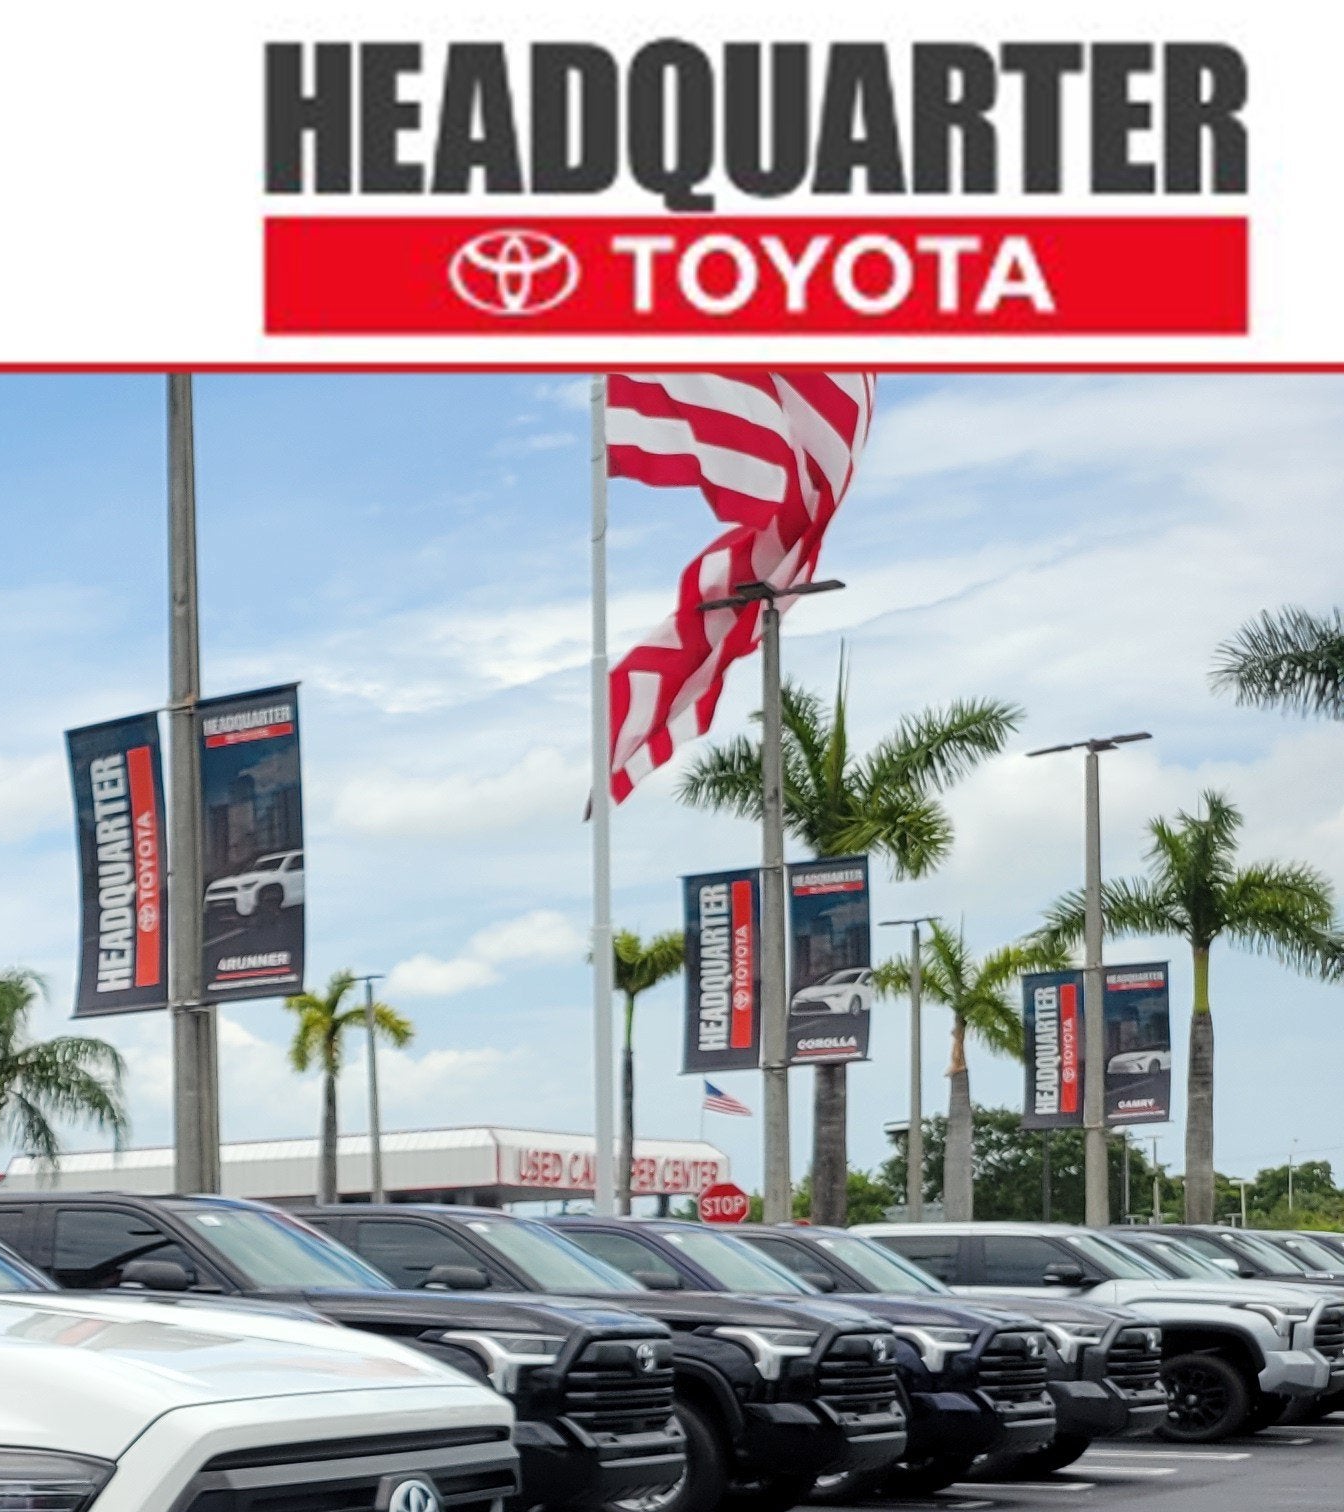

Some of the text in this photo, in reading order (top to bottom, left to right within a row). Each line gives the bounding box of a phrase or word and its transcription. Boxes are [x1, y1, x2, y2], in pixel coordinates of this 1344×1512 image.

[90, 753, 134, 993] HEADQUARTER
[136, 811, 155, 901] TOYOTA
[698, 883, 732, 1051] HEADQUARTER
[734, 924, 749, 989] TOYOTA
[797, 1035, 858, 1050] COROLLA
[1034, 986, 1061, 1115] HEADQUARTER
[518, 1150, 563, 1183] USED
[569, 1152, 598, 1184] CA
[701, 1196, 744, 1217] STOP
